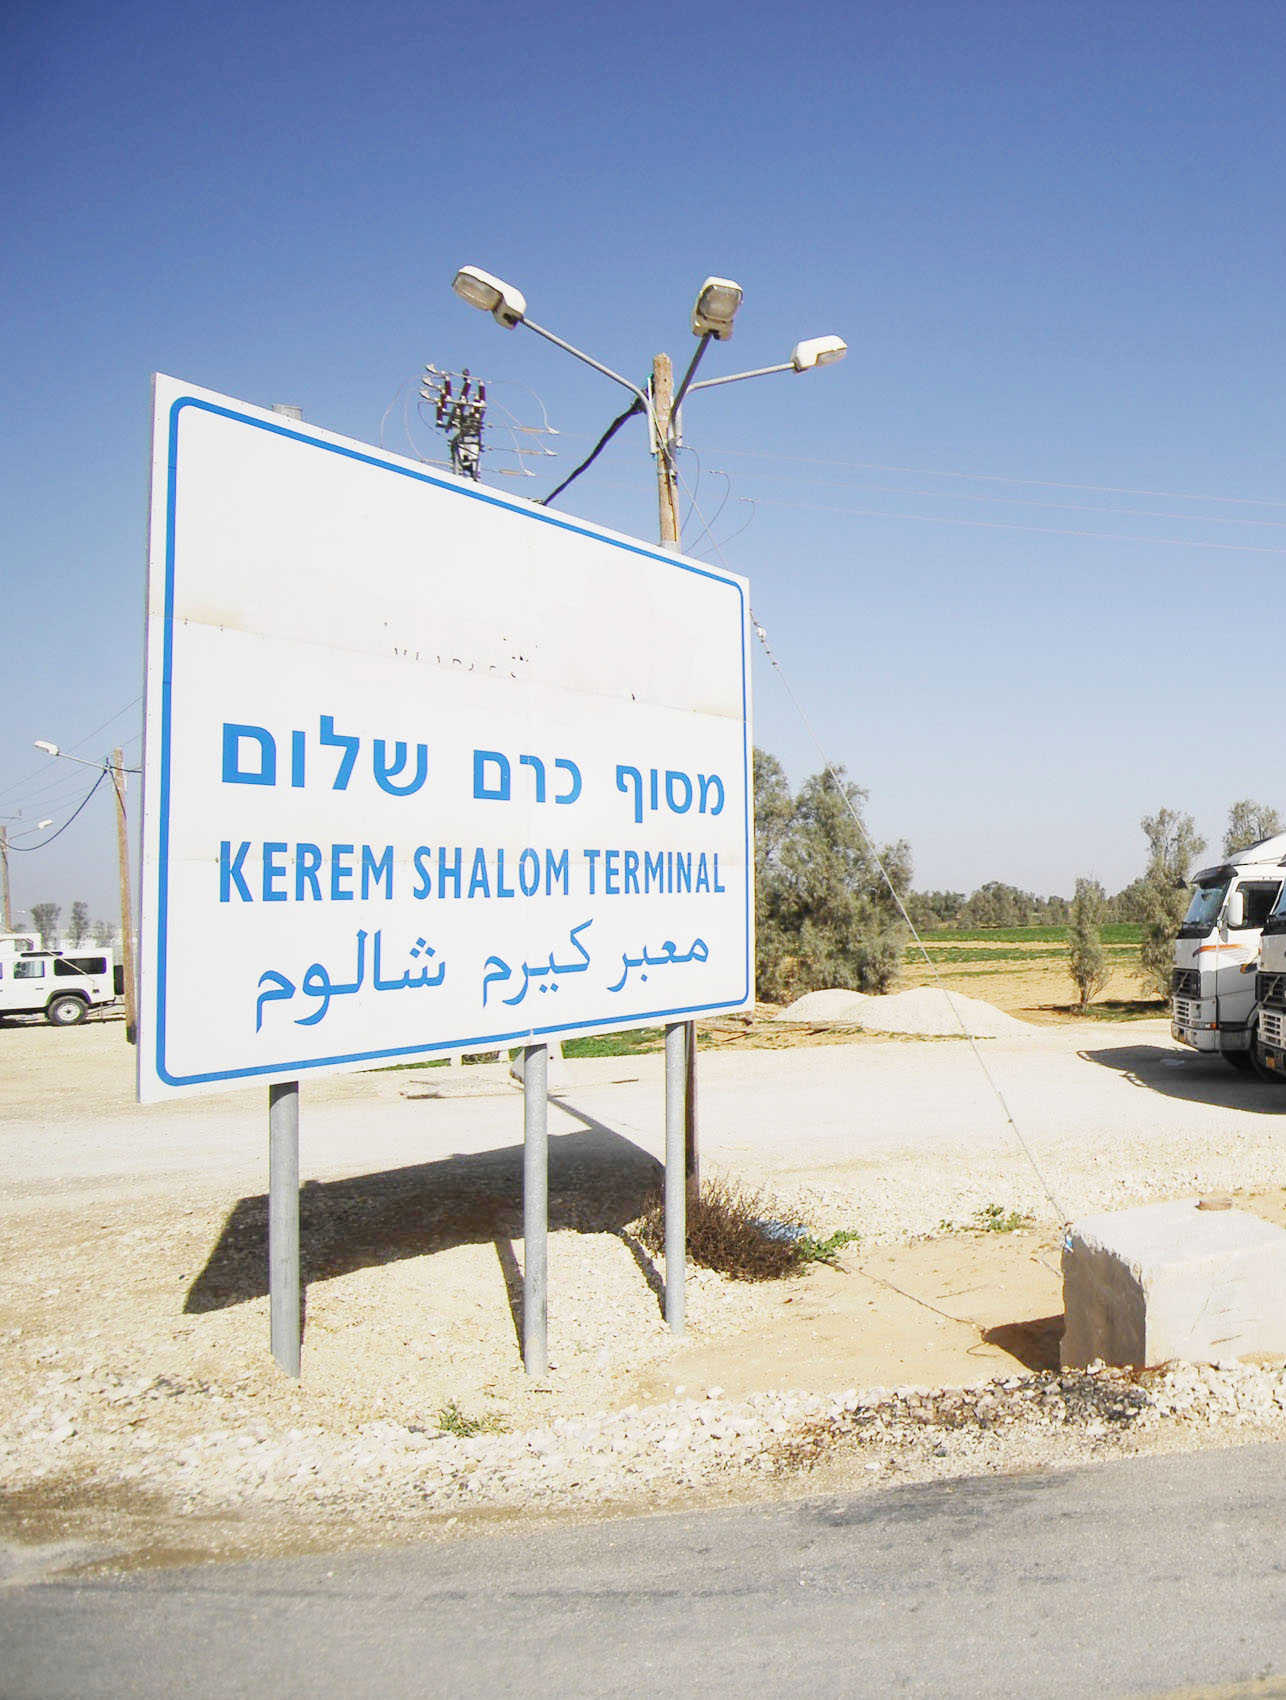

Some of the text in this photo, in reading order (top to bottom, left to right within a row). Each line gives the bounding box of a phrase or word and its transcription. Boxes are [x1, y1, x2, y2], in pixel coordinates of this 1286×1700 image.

[221, 715, 725, 824] מסוף כרם שלום
[219, 841, 726, 903] KEREM SHALOM TERMINAL
[255, 919, 711, 1033] معبر كيرم شالوم
